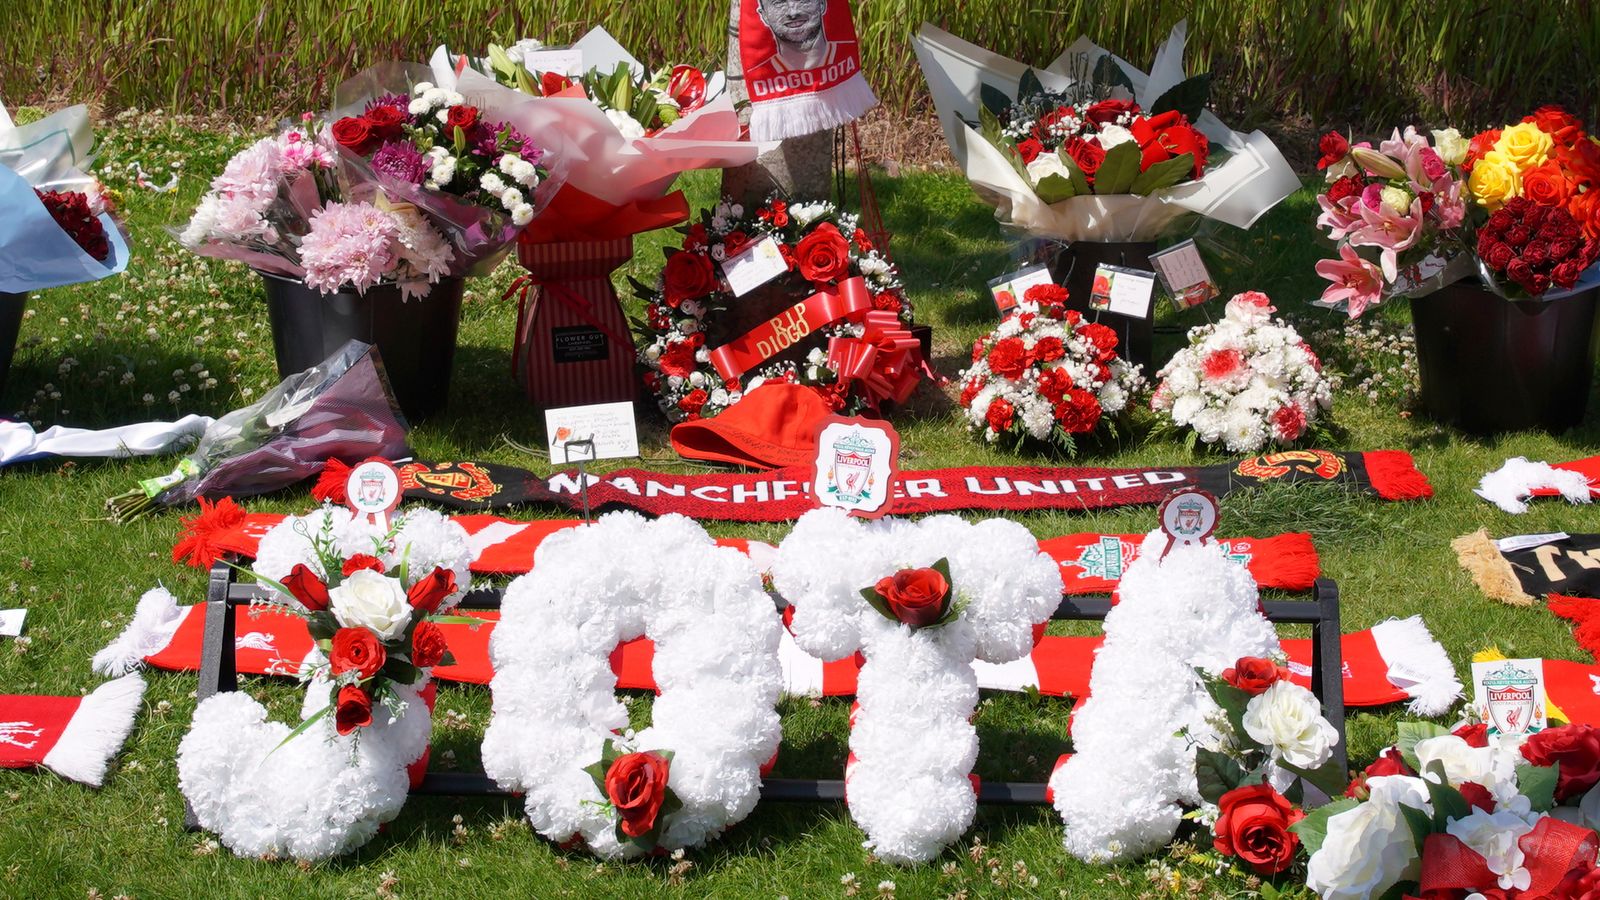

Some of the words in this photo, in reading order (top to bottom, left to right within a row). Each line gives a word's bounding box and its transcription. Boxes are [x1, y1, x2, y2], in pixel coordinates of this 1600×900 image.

[753, 71, 814, 97] DIOGO
[819, 56, 856, 86] JOTA
[756, 319, 810, 359] DIOGO
[837, 455, 870, 467] LIVERPOOL
[548, 472, 948, 503] MANCHER
[964, 471, 1187, 496] UNITED
[1490, 692, 1531, 700] LIVERPOOL
